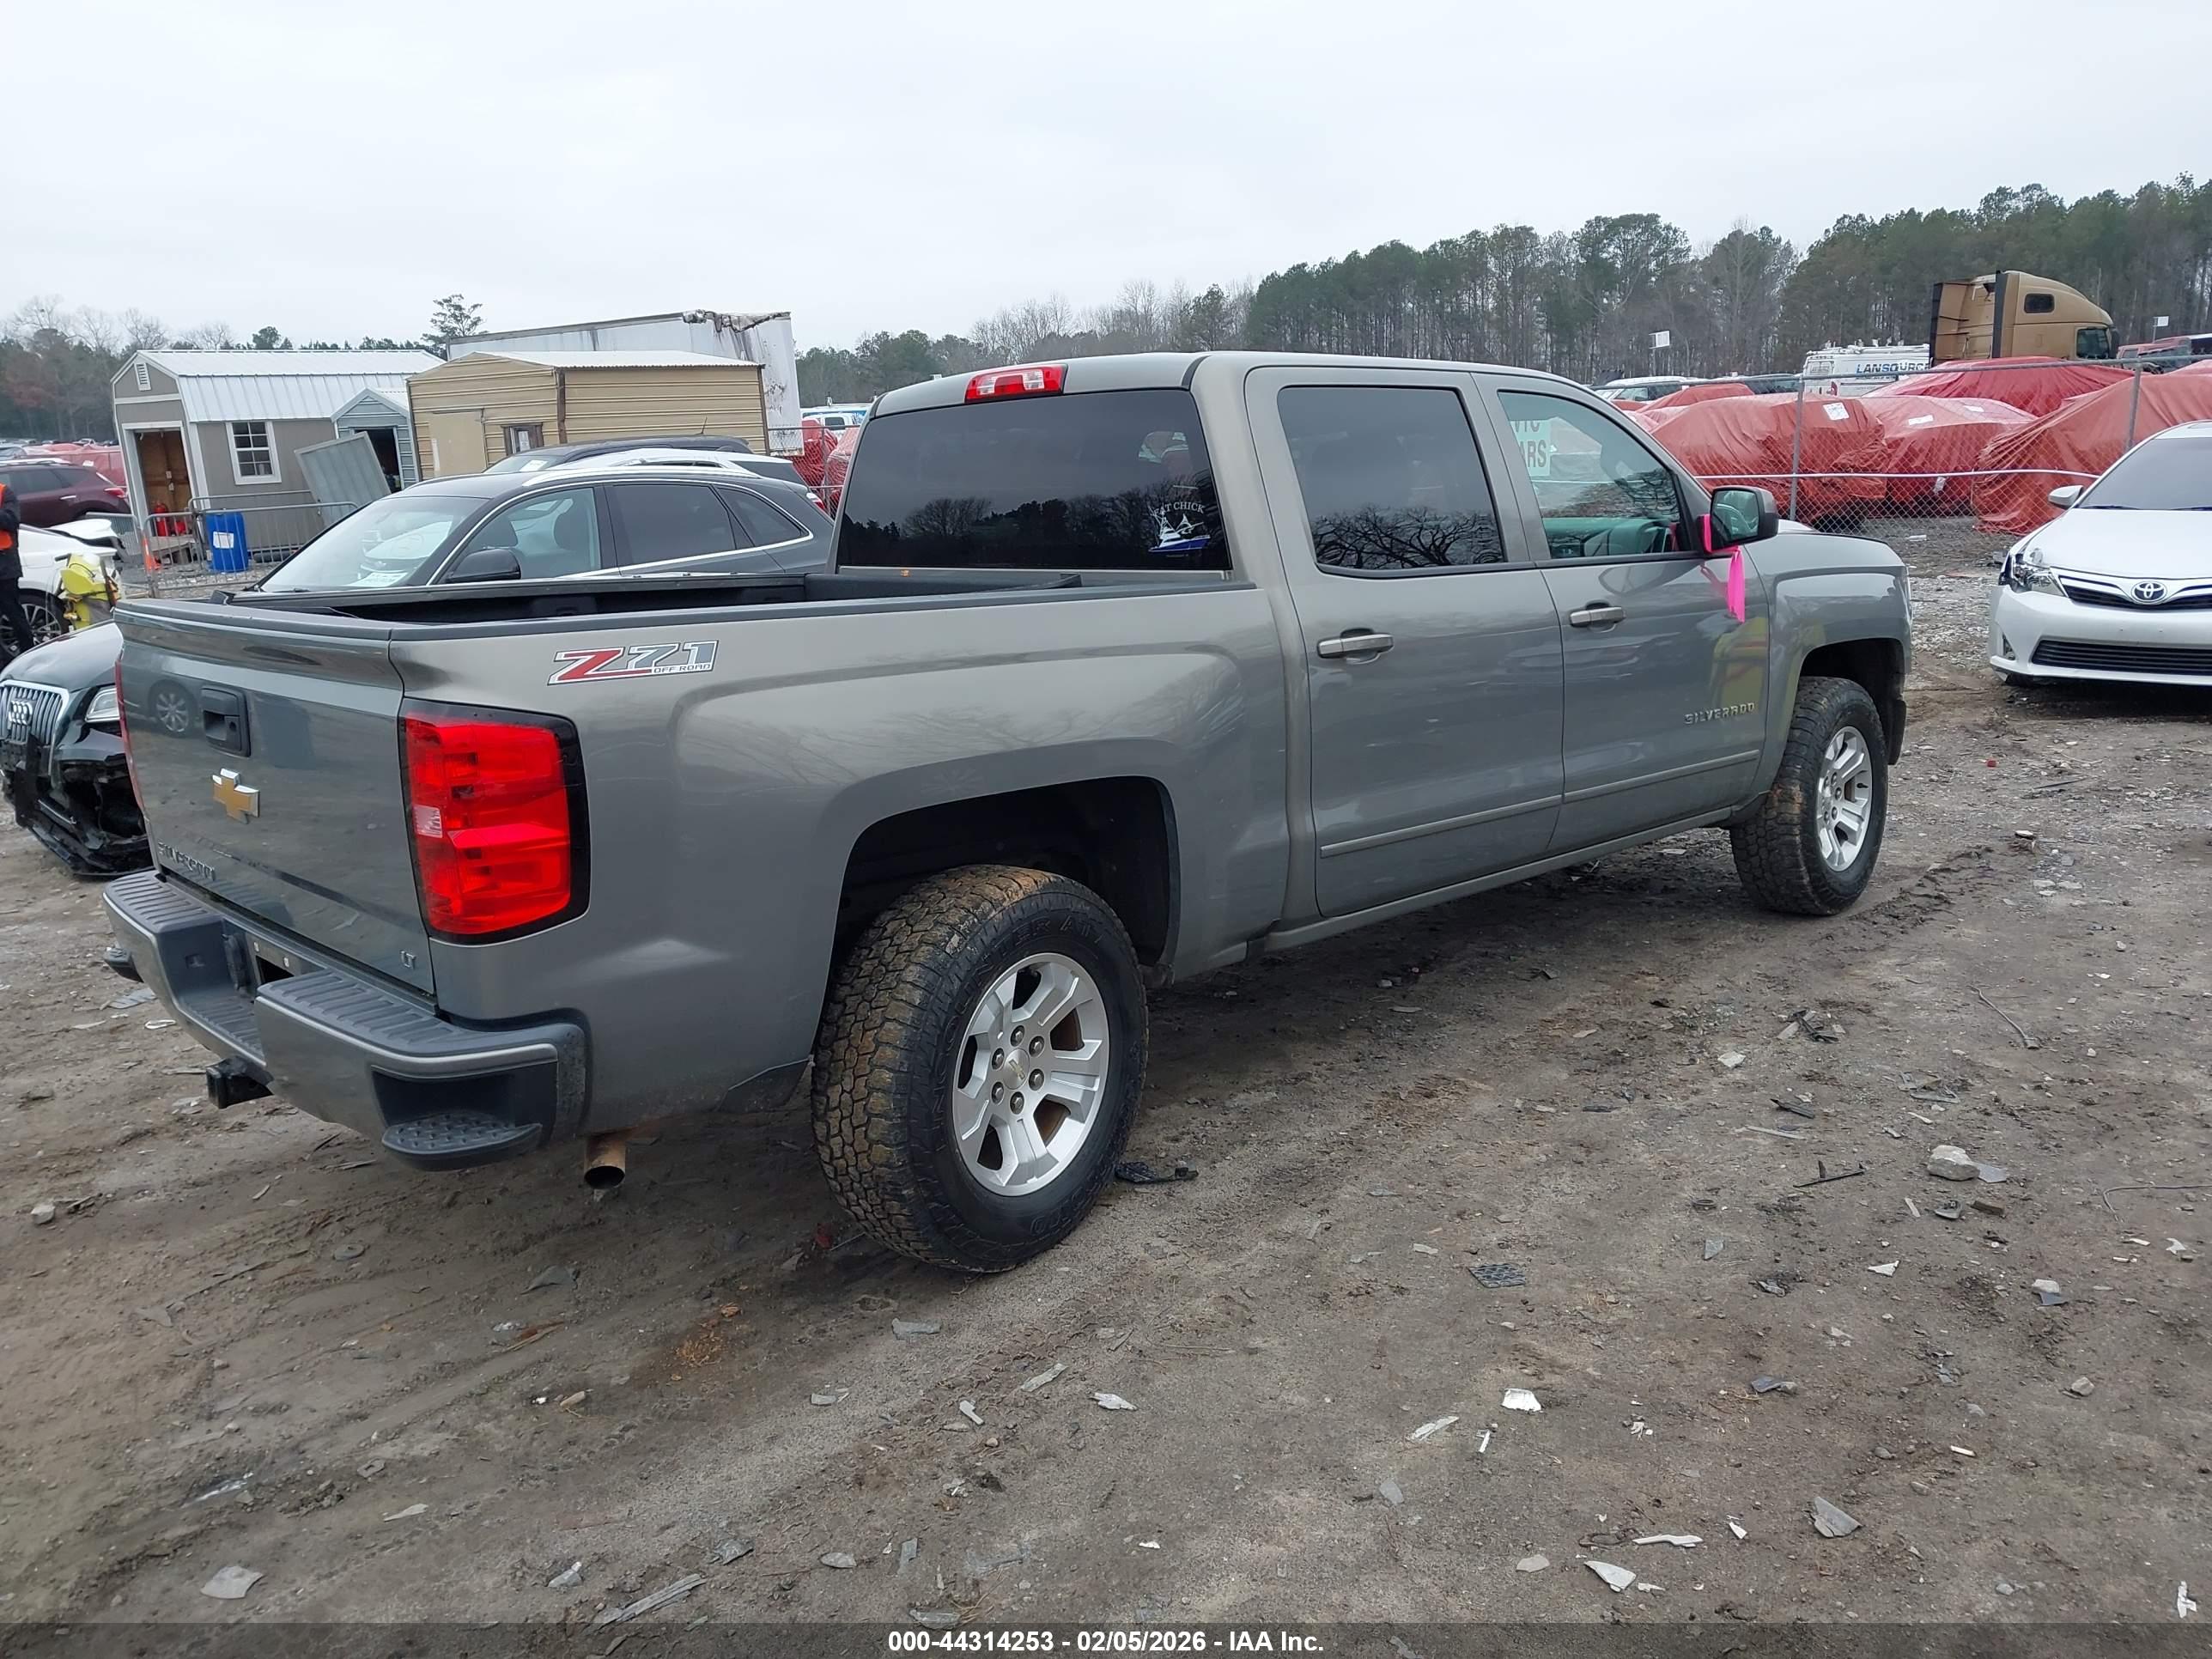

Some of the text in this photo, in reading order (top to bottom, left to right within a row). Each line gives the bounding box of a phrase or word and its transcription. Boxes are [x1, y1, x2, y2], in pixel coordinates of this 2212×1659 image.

[1173, 501, 1204, 514] CHICK
[547, 640, 719, 685] Z71
[653, 663, 712, 674] OFF ROAD
[1684, 702, 1755, 725] SILVERADO
[400, 950, 416, 969] LT
